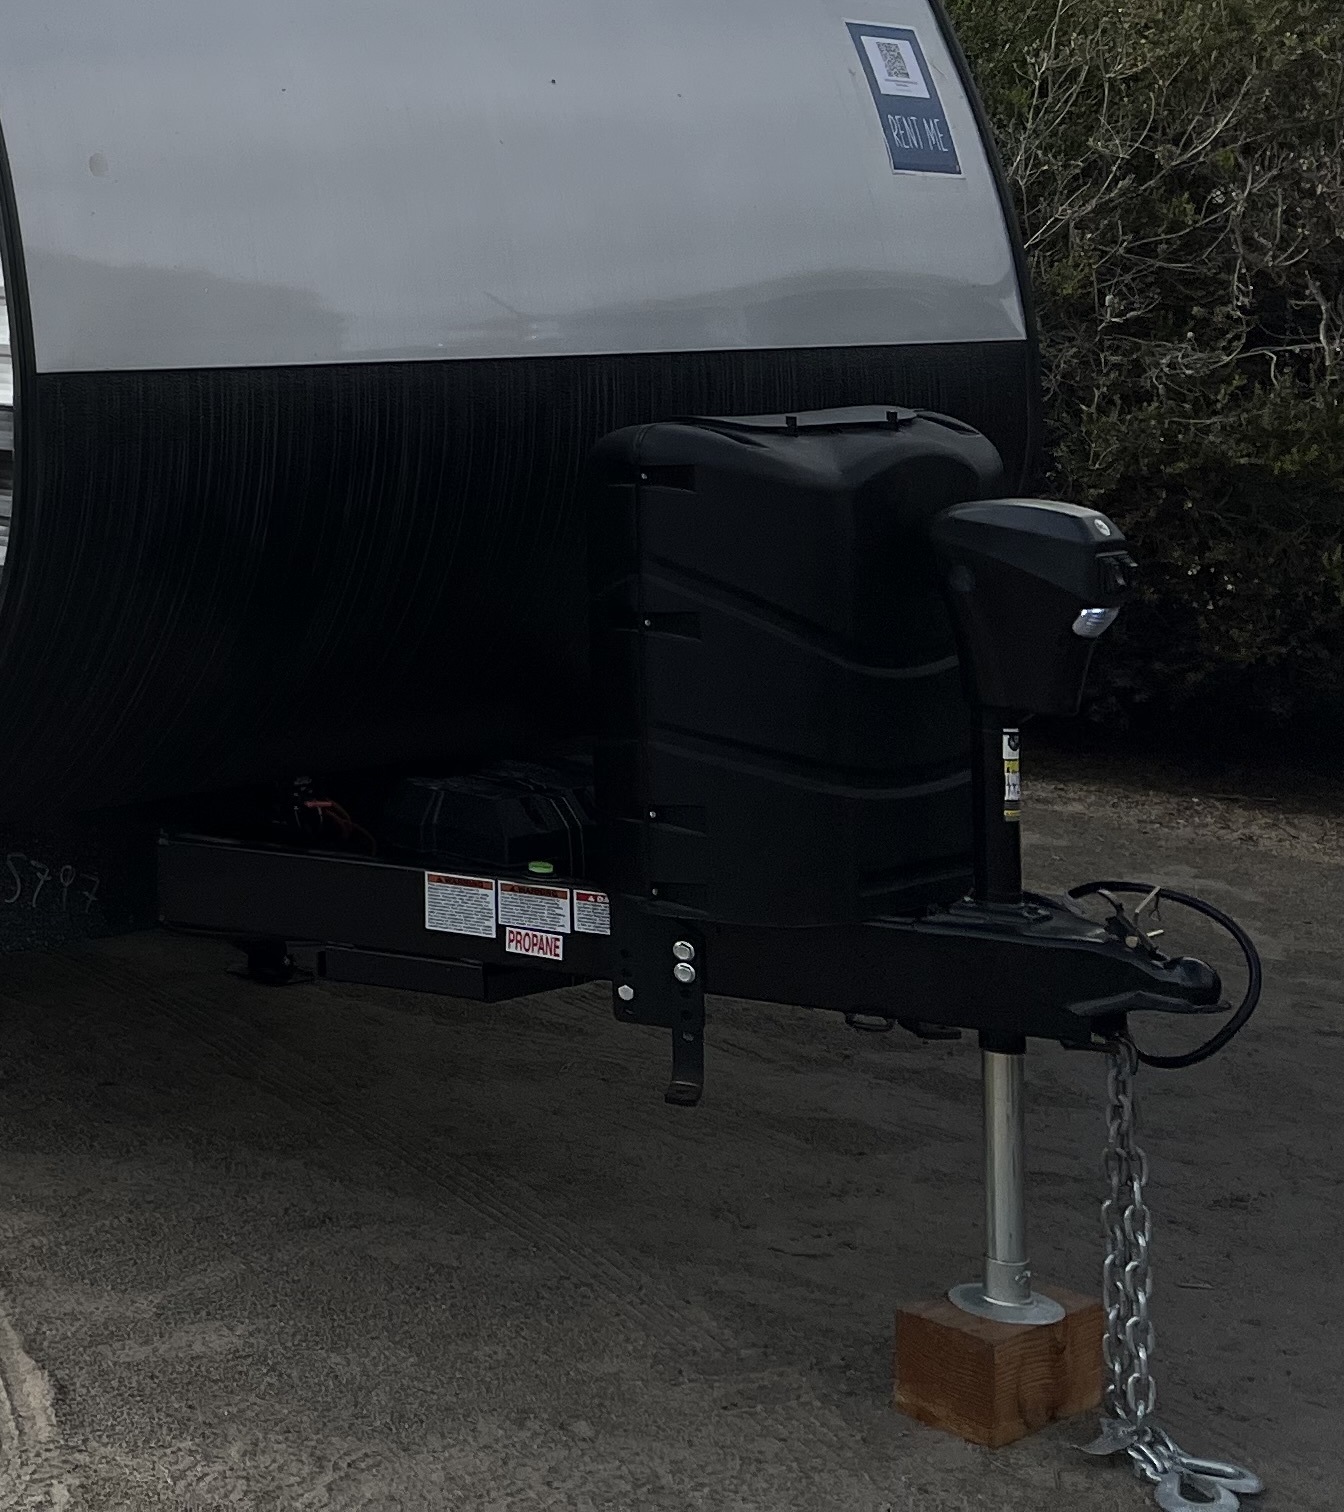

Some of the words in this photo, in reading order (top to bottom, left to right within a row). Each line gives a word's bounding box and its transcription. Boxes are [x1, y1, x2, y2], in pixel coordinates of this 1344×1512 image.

[887, 114, 924, 150] RENT
[922, 117, 949, 152] ME
[507, 929, 561, 958] PROPANE
